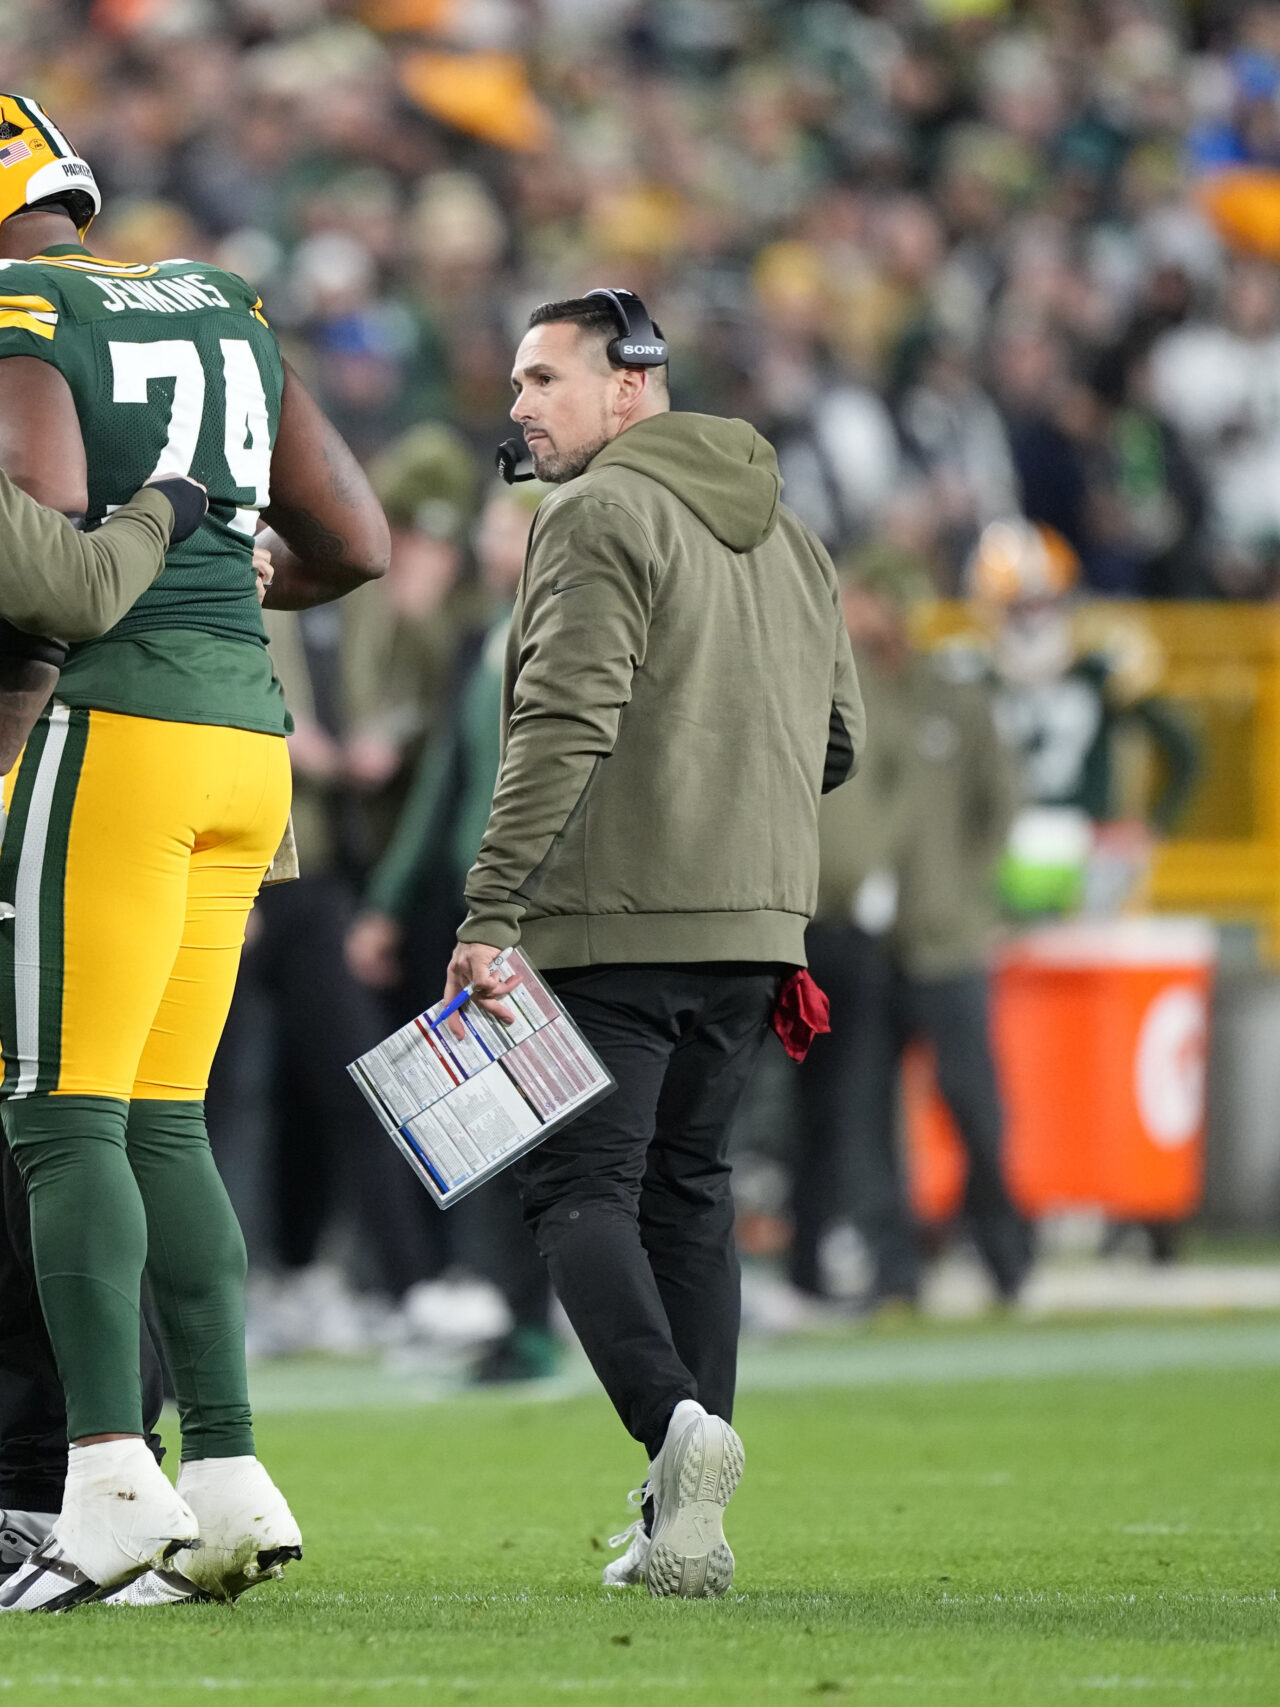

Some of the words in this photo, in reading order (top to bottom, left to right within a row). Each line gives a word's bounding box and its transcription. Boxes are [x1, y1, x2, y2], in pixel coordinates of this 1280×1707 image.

[86, 274, 231, 313] JENKINS
[623, 345, 665, 356] SONY
[108, 339, 272, 538] 74
